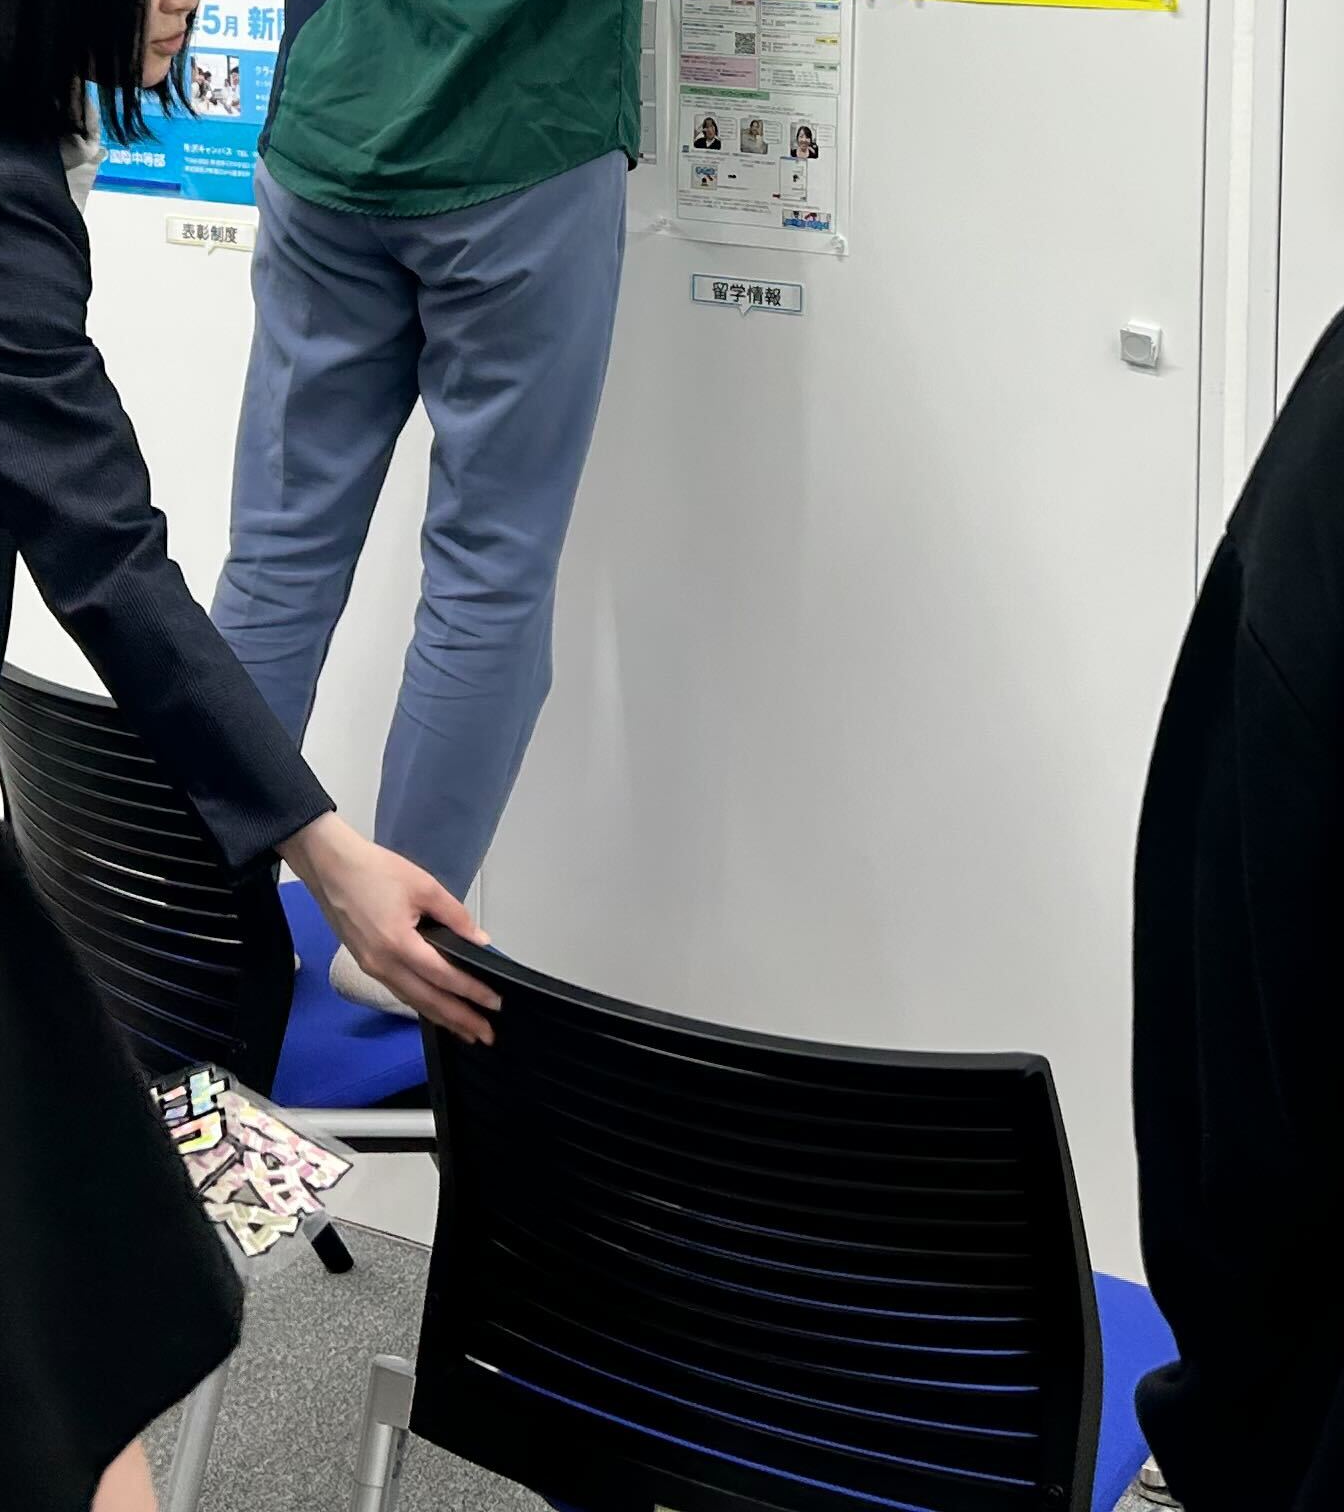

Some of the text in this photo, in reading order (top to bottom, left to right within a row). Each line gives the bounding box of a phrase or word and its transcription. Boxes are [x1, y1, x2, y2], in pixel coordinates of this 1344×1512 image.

[193, 4, 286, 41] 5月 新
[182, 223, 238, 245] 表彰制度
[712, 281, 781, 307] 留学情報
